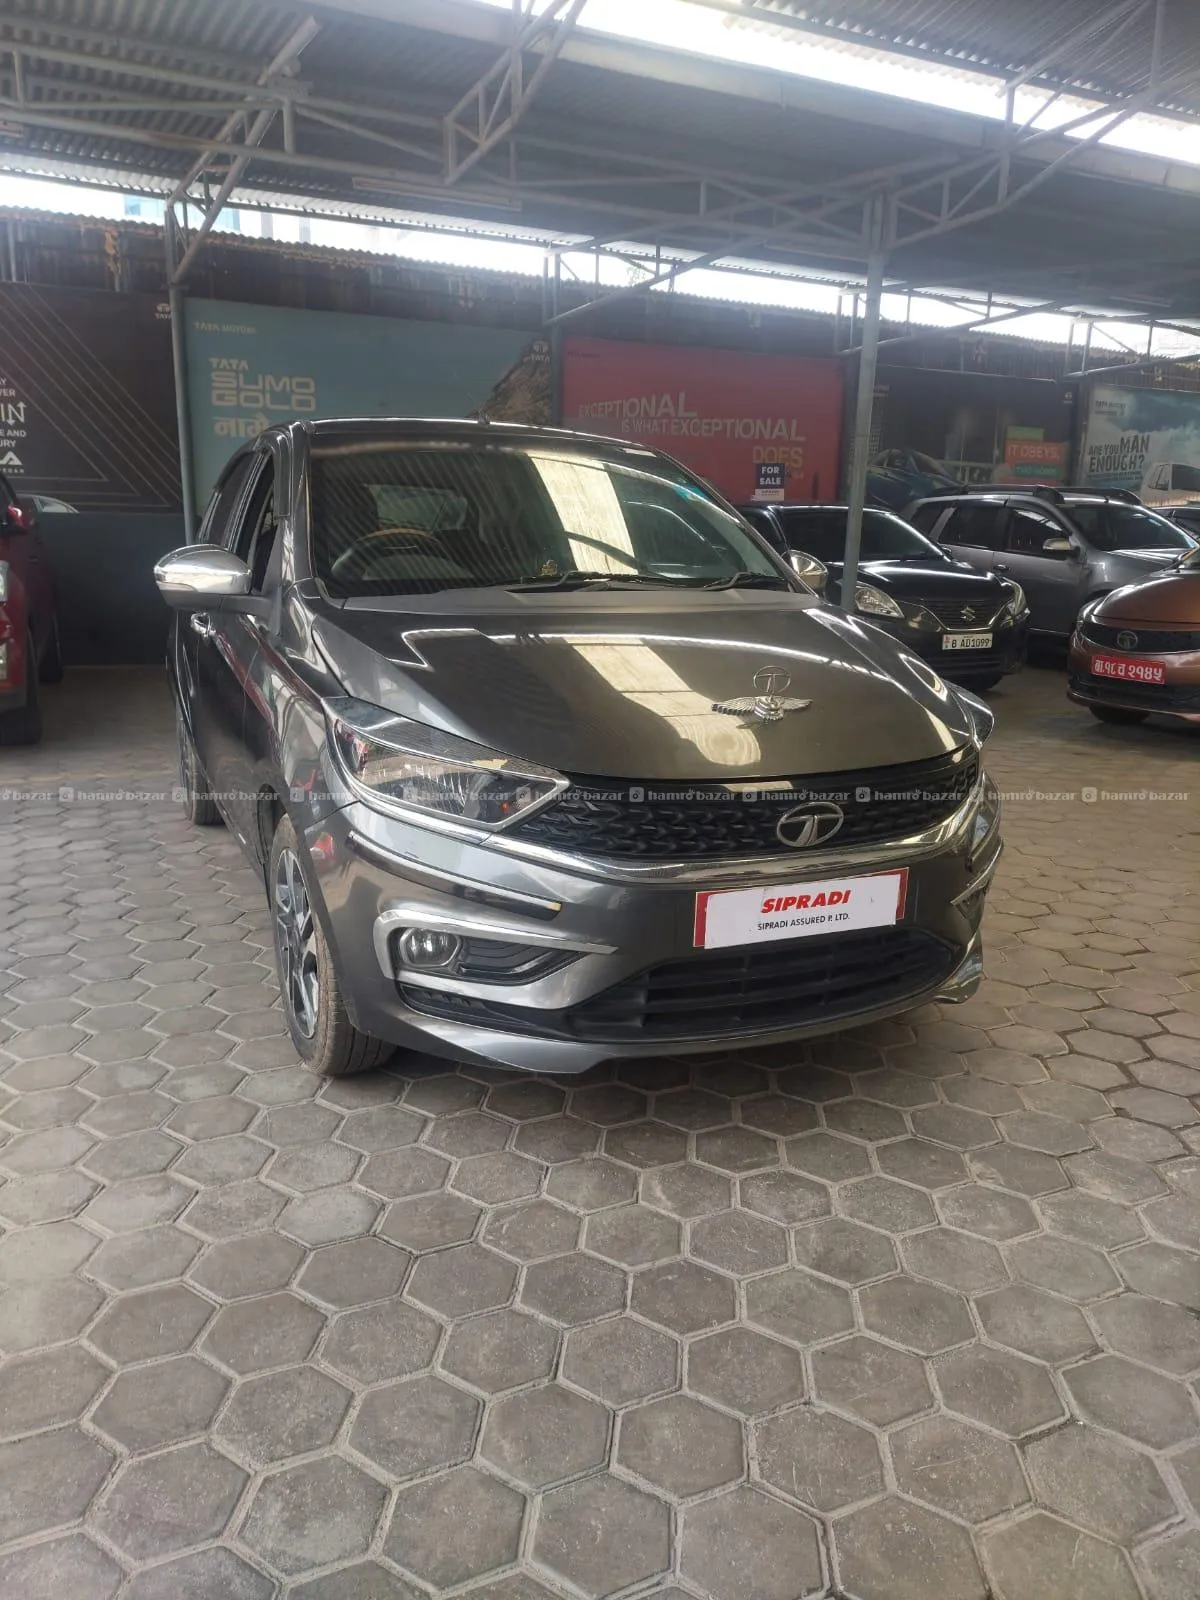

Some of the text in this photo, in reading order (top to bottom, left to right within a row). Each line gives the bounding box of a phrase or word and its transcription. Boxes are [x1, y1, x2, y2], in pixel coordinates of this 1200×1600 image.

[209, 358, 249, 371] TATA
[210, 370, 316, 394] SUMO
[211, 388, 316, 412] GOLD
[578, 391, 698, 418] EXCEPTIONAL
[621, 418, 806, 442] IS WHAT EXCEPTIONAL
[1088, 435, 1151, 456] ARE YOU MAN
[761, 466, 780, 474] FOR
[1088, 454, 1146, 473] ENOUGH?
[760, 477, 781, 485] SALE
[760, 889, 852, 914] SIPRADI
[757, 921, 789, 931] SIPRADI
[790, 915, 826, 926] ASSURED
[834, 912, 850, 921] LTD.
